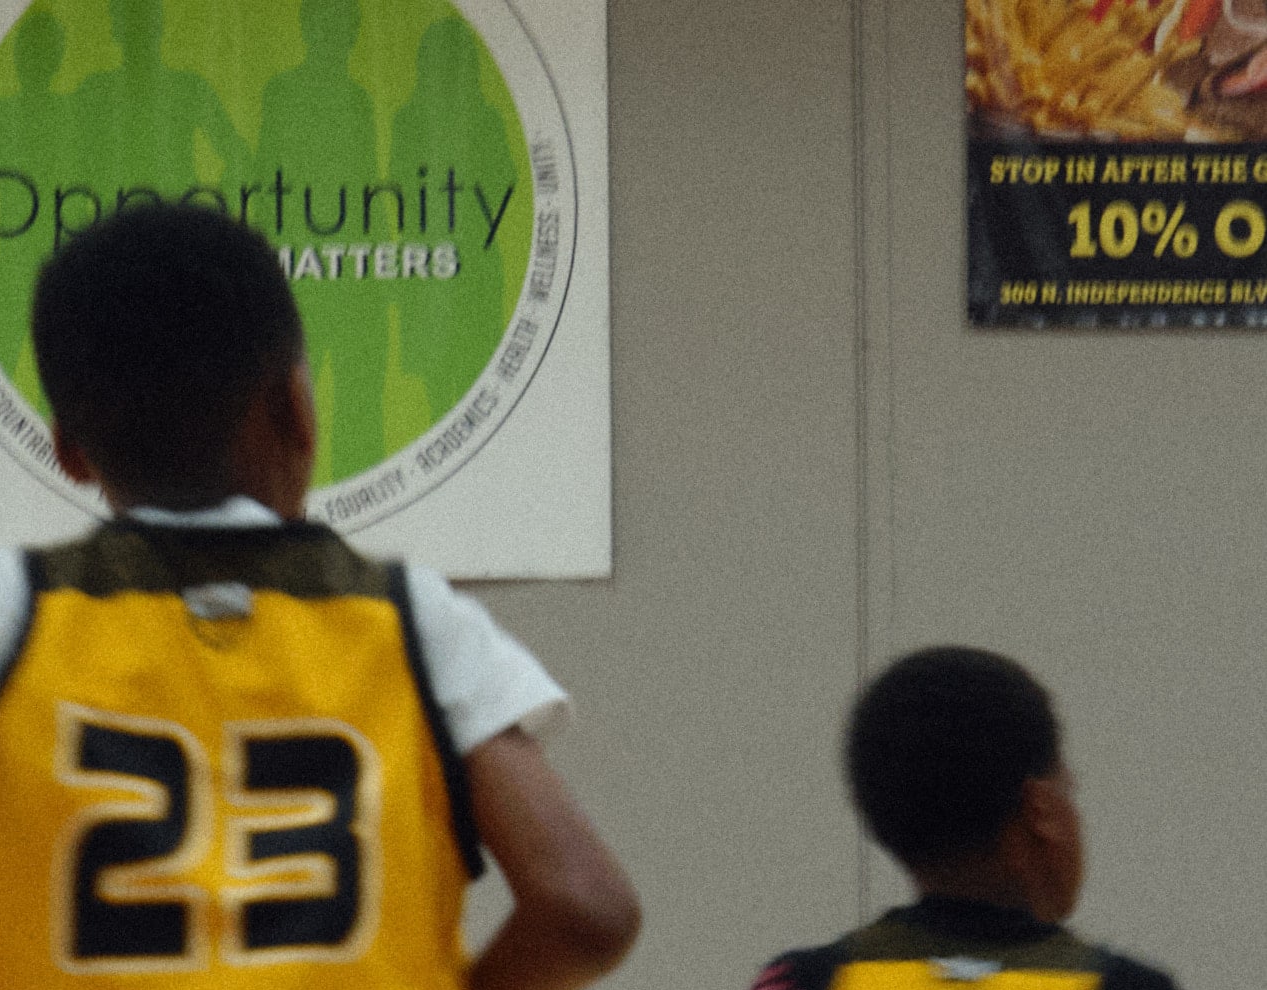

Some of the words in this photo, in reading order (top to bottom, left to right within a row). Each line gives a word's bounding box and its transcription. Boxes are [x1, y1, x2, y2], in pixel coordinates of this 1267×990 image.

[989, 154, 1061, 184] STOP
[1065, 154, 1096, 184] IN
[1100, 154, 1188, 184] AFTER
[1192, 154, 1248, 184] THE
[1067, 198, 1199, 260] 10%
[1065, 279, 1227, 305] INDEPENDENCE
[50, 700, 384, 975] 23
